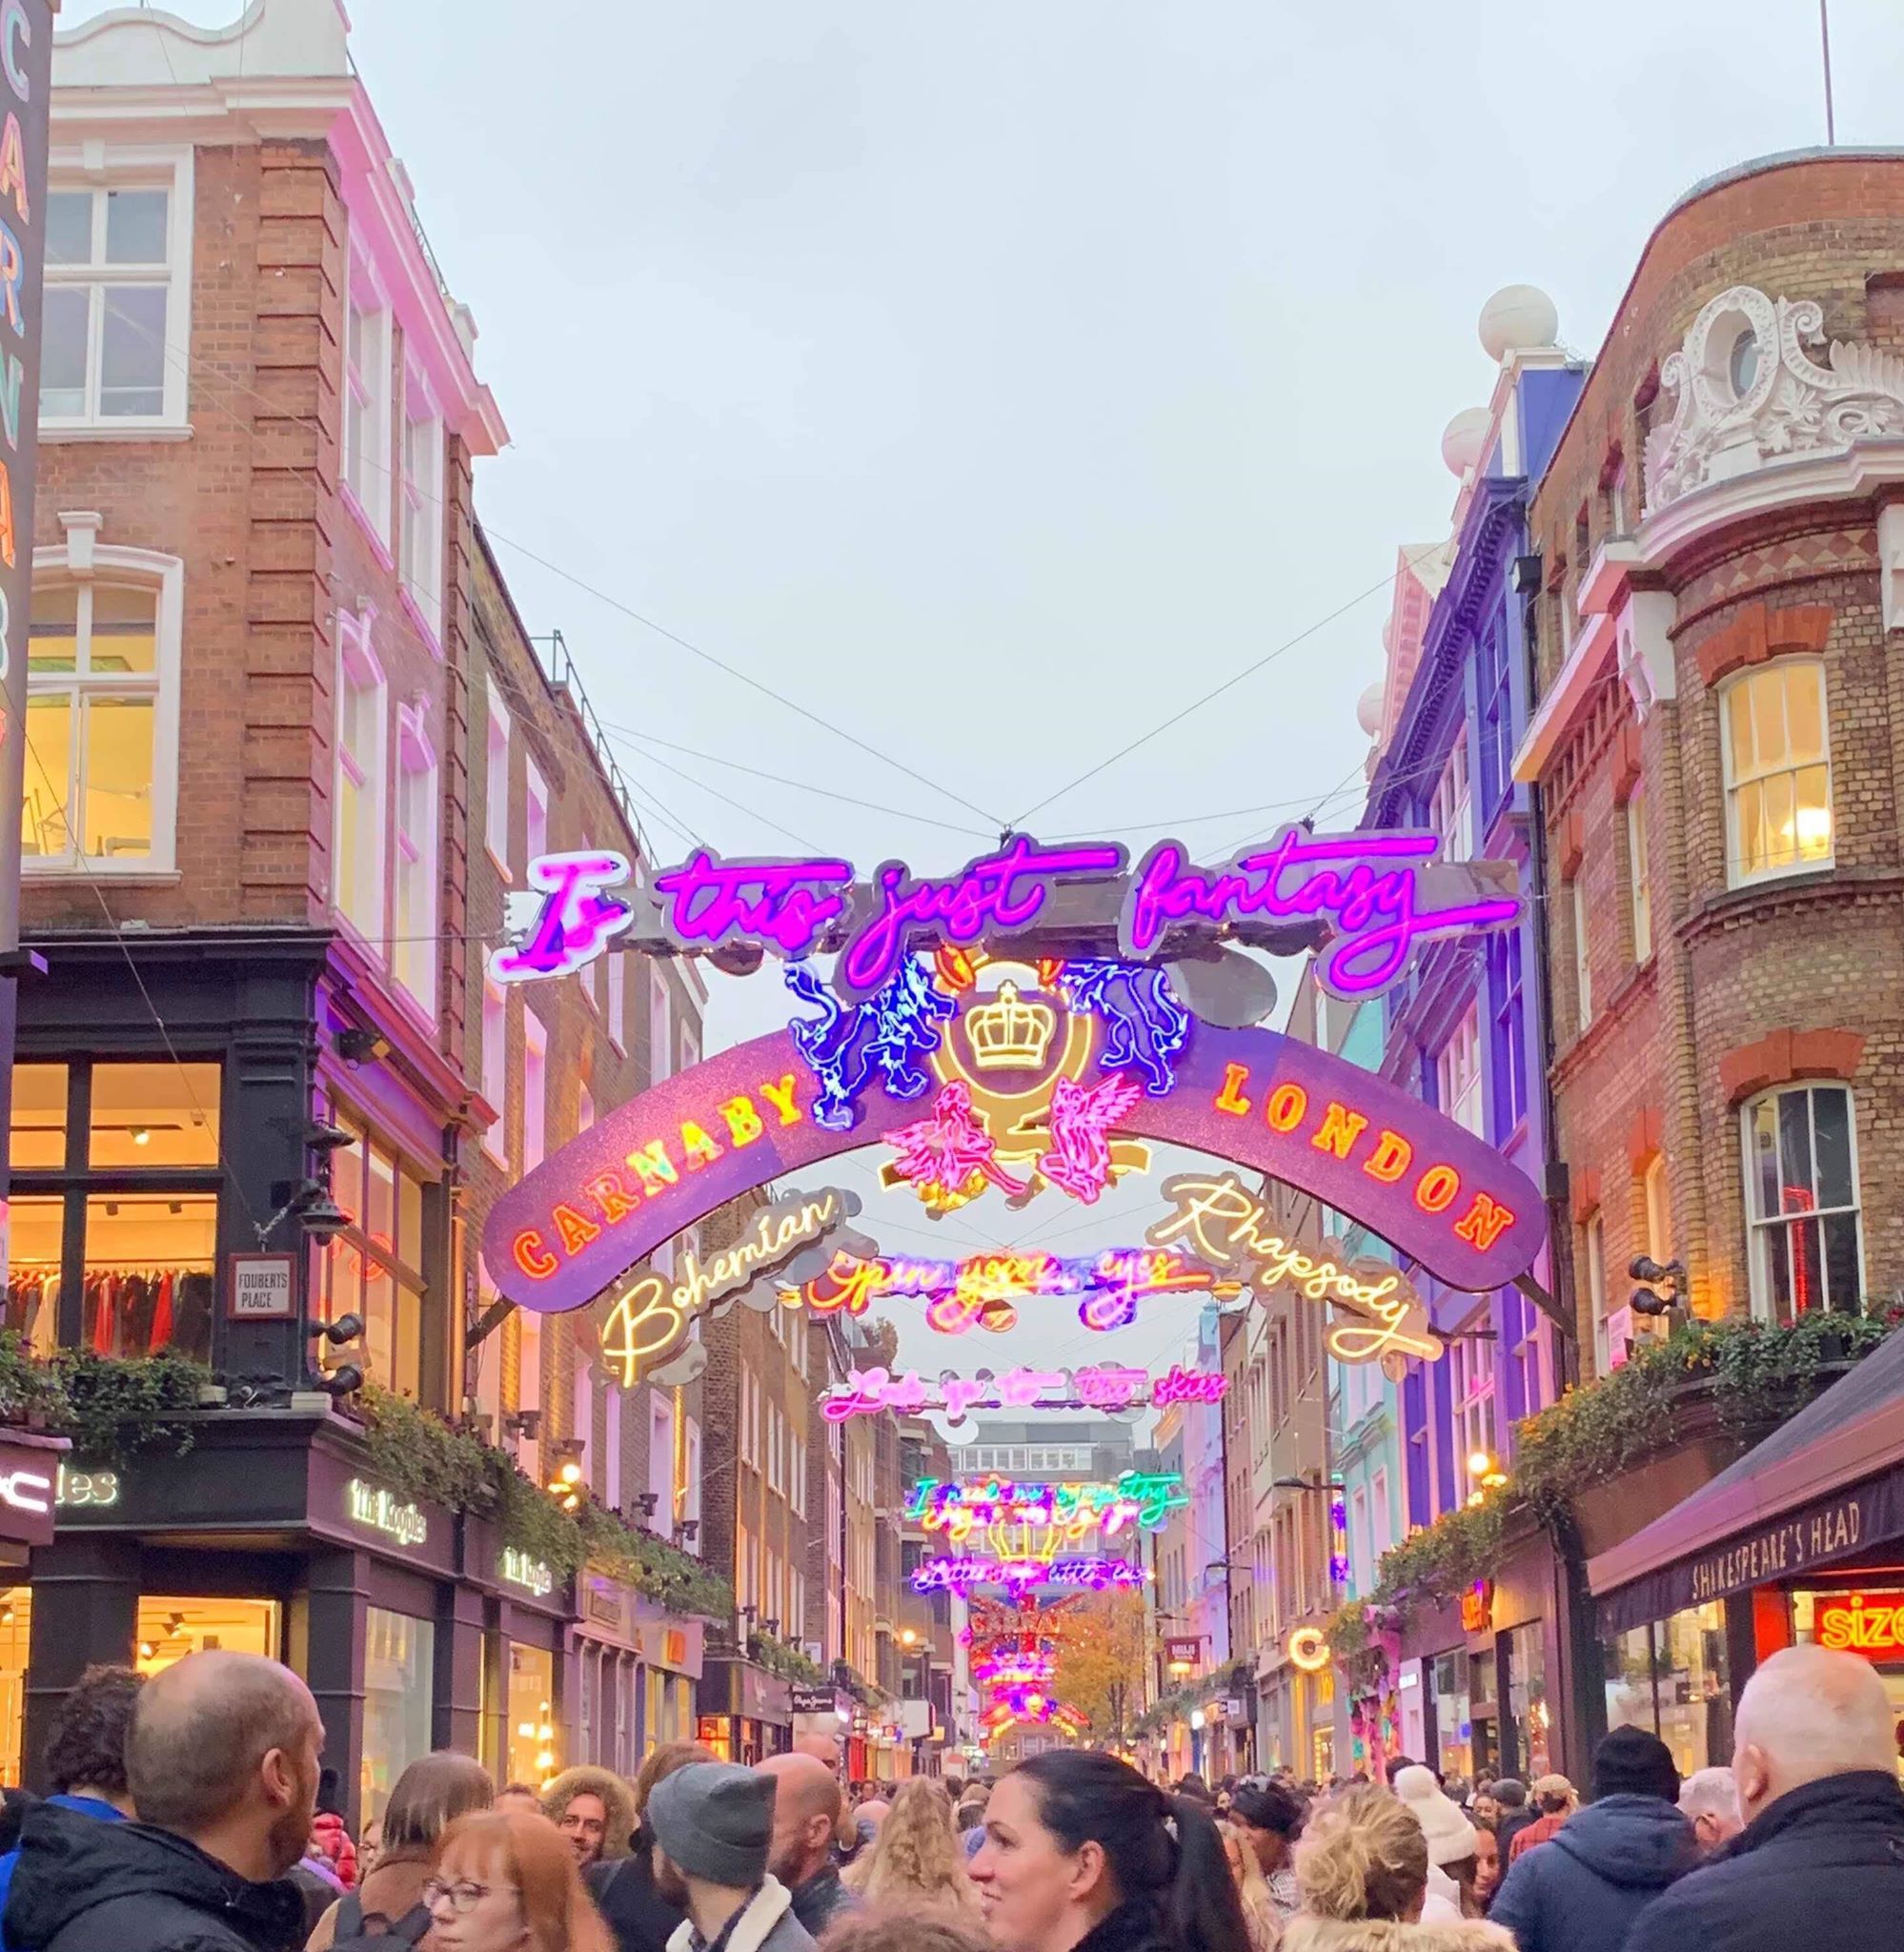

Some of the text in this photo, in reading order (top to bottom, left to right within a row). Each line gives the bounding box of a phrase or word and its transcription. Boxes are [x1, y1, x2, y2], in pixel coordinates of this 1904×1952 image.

[655, 853, 851, 950] this
[846, 838, 1120, 988] just
[1135, 831, 1520, 991] fantasy
[512, 1074, 801, 1280] CARNABY
[1215, 1063, 1515, 1251] LONDON
[241, 1291, 273, 1308] PLACE
[603, 1193, 835, 1388] Bohemian
[1154, 1179, 1439, 1357] Rhapsody
[1811, 1501, 1860, 1556] HEAD
